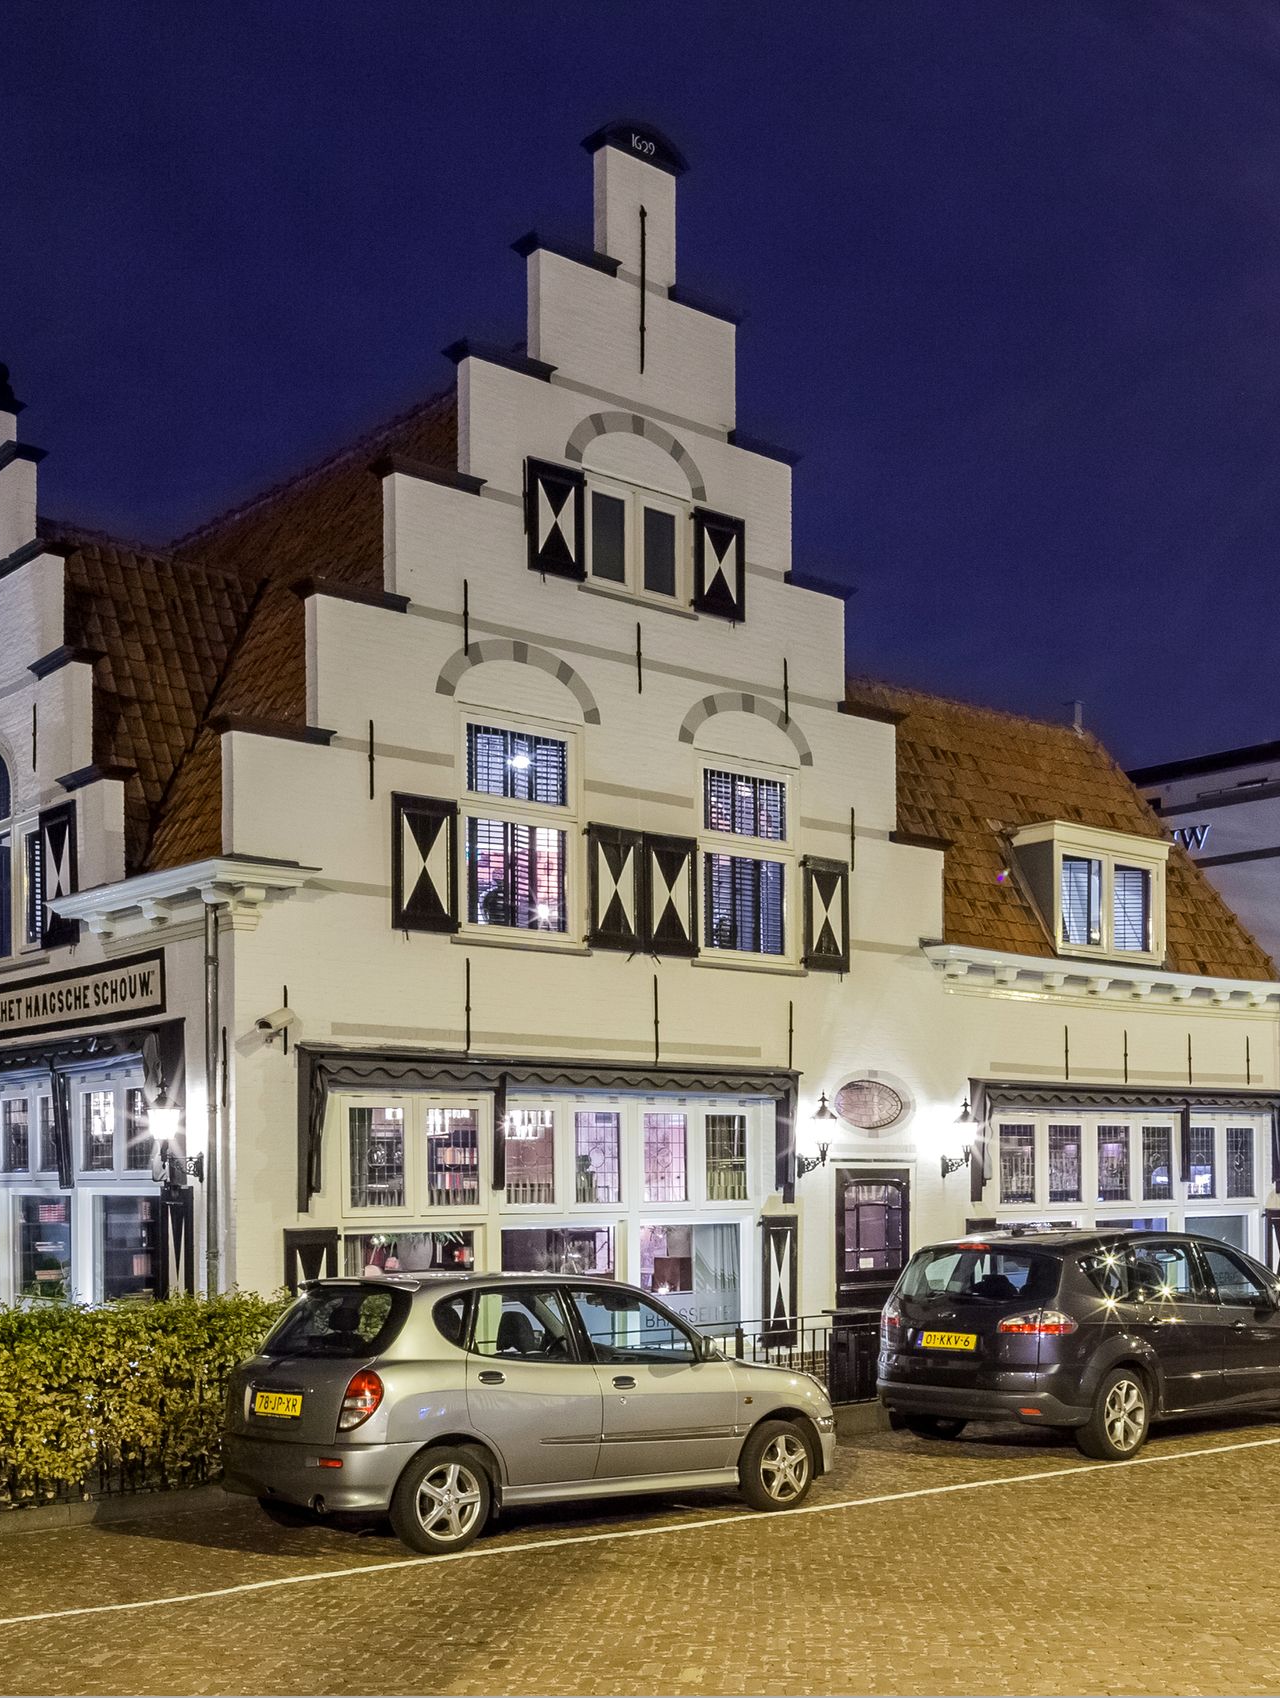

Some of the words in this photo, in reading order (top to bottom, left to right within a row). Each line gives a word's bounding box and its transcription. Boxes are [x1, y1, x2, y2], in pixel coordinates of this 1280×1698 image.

[25, 985, 90, 1018] HAAGSCHE
[925, 1333, 971, 1347] 01-KKV-6
[258, 1394, 298, 1413] 78-JP-XR
